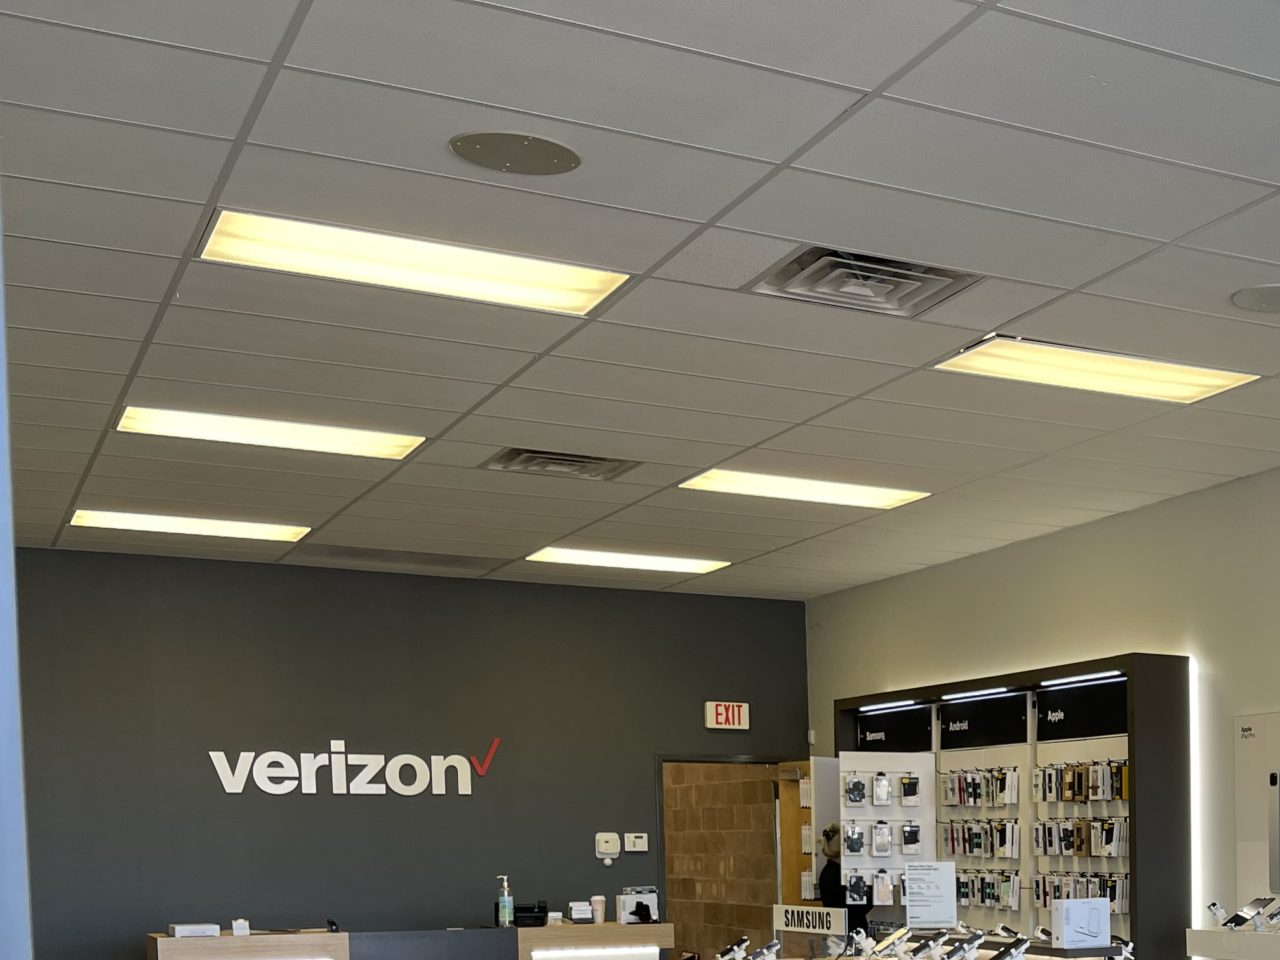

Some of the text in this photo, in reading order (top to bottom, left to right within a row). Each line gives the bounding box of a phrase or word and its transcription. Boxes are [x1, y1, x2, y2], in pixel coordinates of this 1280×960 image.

[714, 703, 743, 727] EXIT
[949, 720, 968, 731] Android
[1047, 709, 1064, 723] Apple
[209, 740, 473, 796] verizon
[784, 909, 832, 931] SAMSUNG
